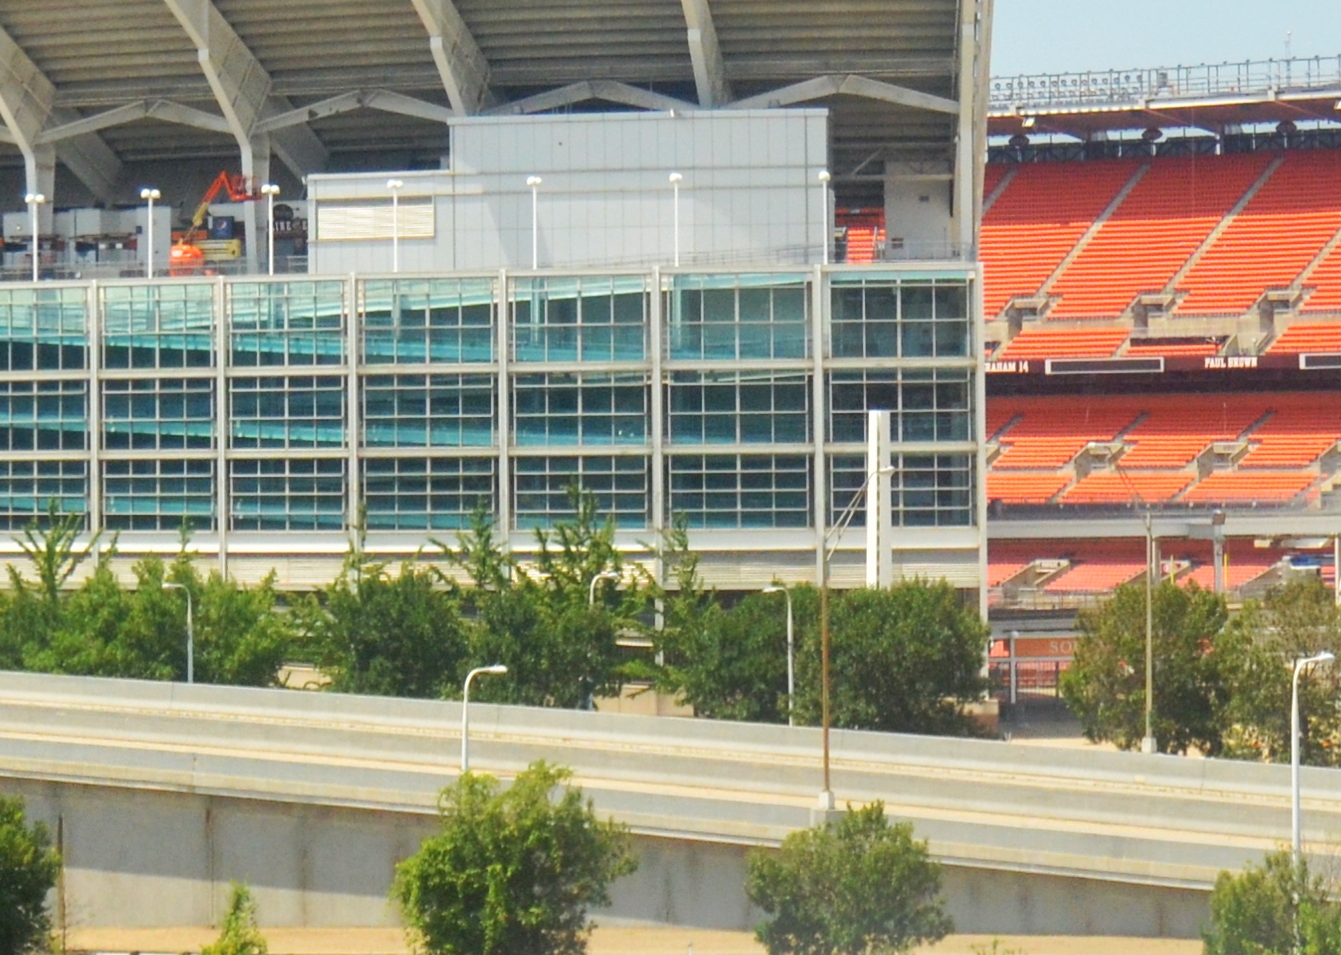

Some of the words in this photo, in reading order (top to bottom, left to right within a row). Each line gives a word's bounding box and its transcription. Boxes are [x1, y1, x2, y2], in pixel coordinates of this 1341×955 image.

[985, 361, 1017, 373] RAHAM
[1204, 357, 1227, 369] PAUL
[1228, 356, 1258, 368] BROWN
